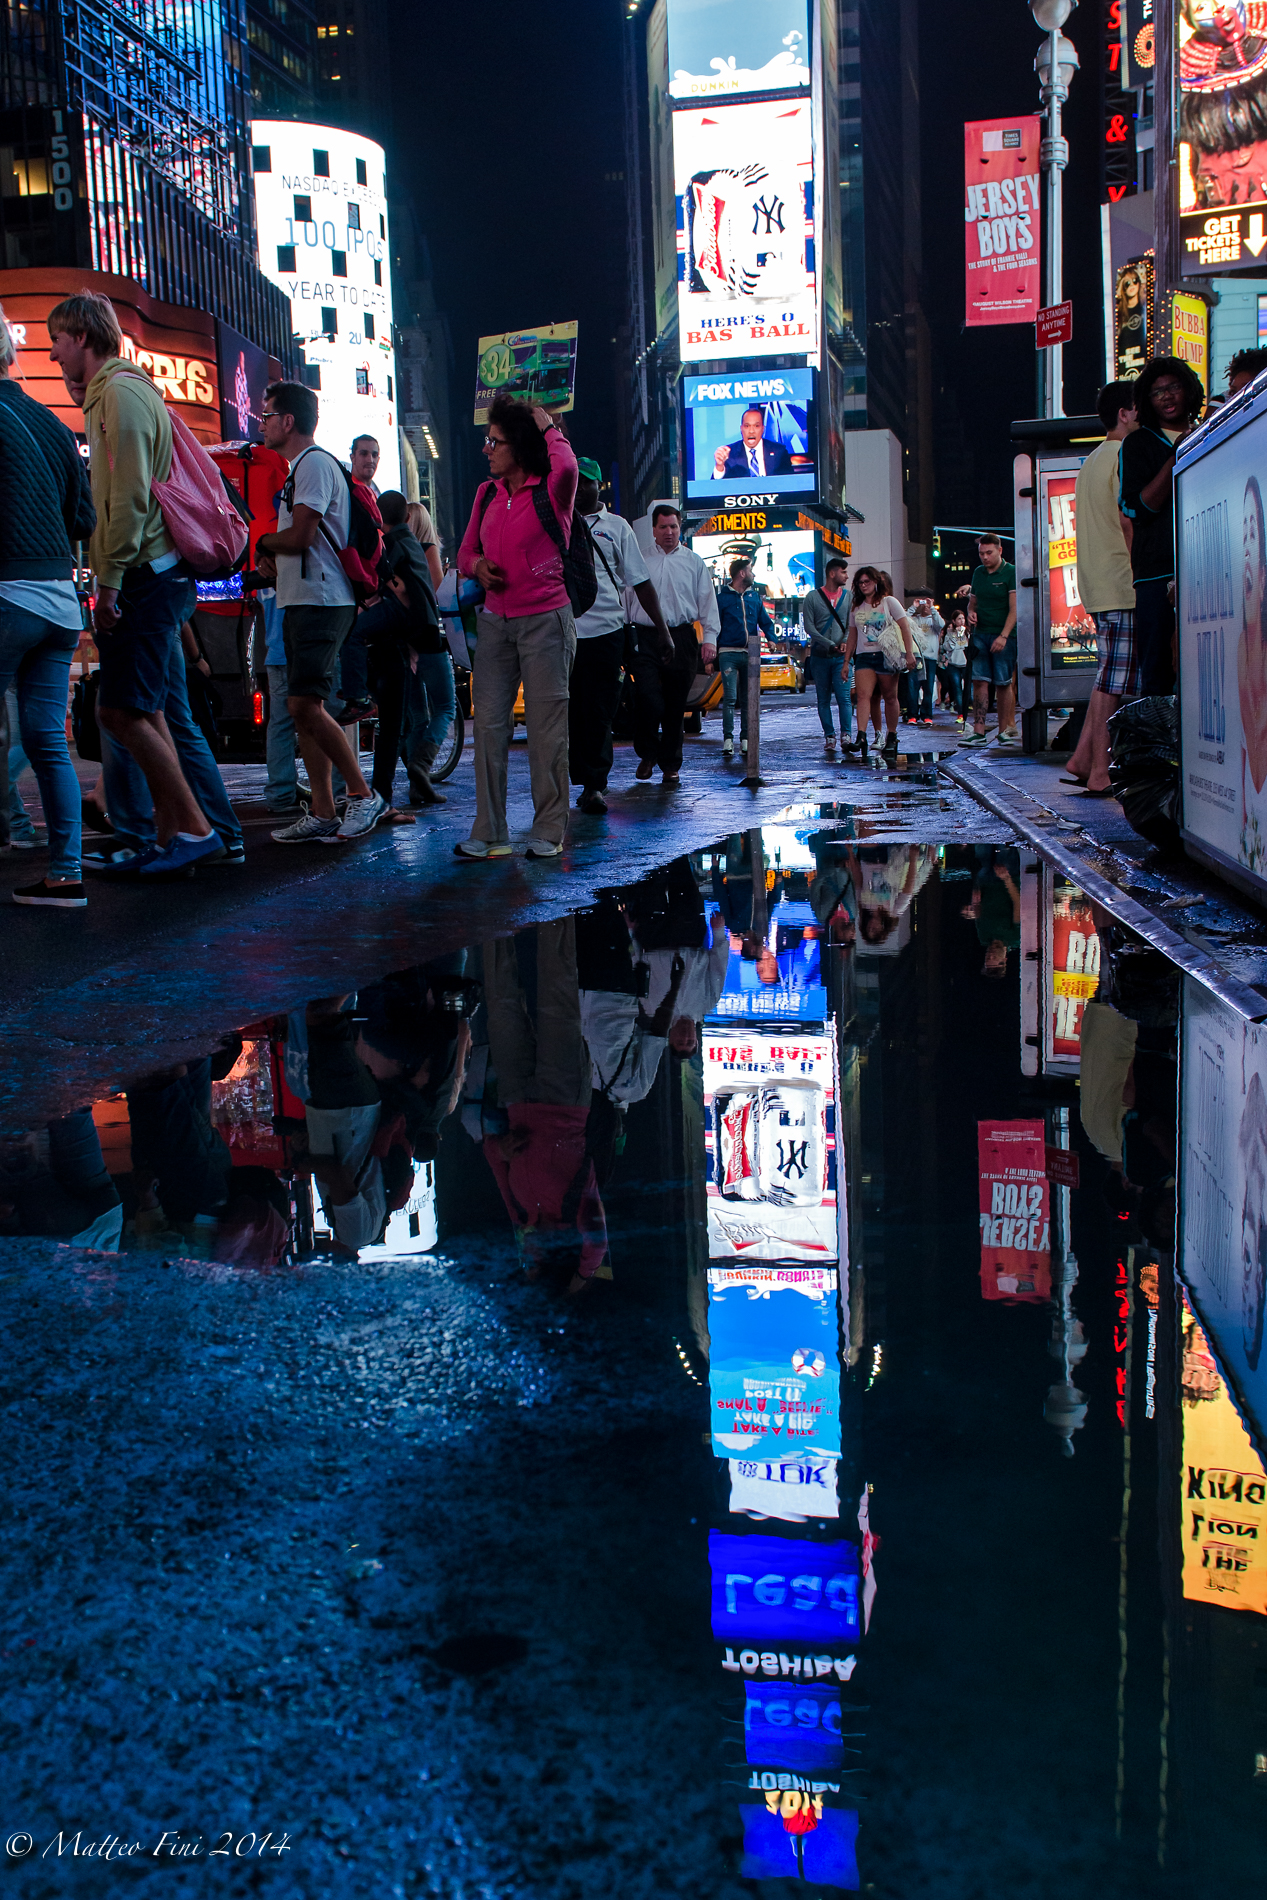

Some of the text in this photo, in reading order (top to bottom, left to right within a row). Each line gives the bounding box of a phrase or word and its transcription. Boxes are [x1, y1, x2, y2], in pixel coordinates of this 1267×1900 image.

[1105, 114, 1128, 143] &
[51, 110, 73, 211] 1500
[282, 175, 338, 196] NASDAQ
[965, 173, 1040, 223] JERSEY
[285, 217, 337, 249] 100
[977, 213, 1033, 258] BOYS
[1203, 214, 1242, 236] GET
[1185, 231, 1241, 252] TICKETS
[1199, 245, 1241, 265] HERE
[288, 281, 335, 301] YEAR
[340, 285, 358, 305] TO
[1037, 305, 1070, 323] NO STANDING
[1041, 317, 1067, 332] ANYTIME
[1174, 305, 1206, 337] BUBBA
[348, 331, 362, 345] 2U
[1176, 335, 1204, 364] GUMP
[481, 350, 510, 382] $34
[476, 388, 497, 399] FREE
[697, 379, 785, 401] FOX NEWS
[724, 494, 778, 508] SONY
